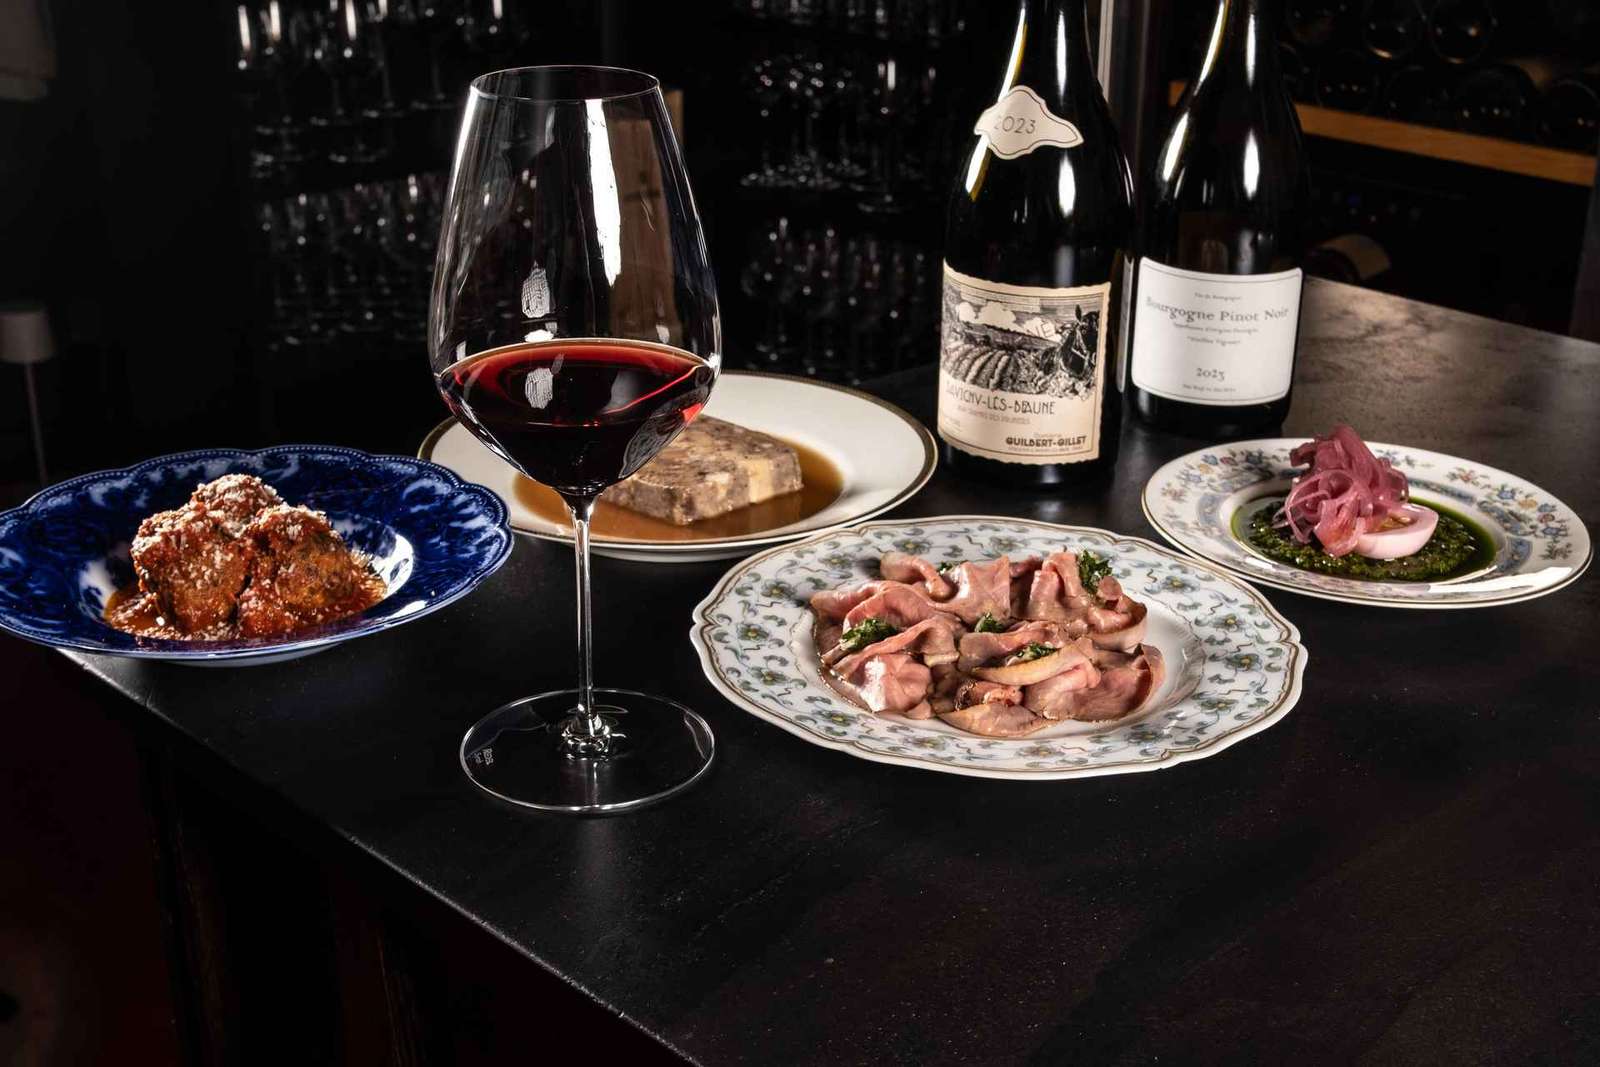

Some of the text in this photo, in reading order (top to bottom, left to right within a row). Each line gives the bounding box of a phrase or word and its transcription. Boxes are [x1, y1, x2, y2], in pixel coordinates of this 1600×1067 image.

[1220, 310, 1259, 322] Pinot
[1264, 308, 1289, 320] Noir
[1196, 367, 1225, 381] 2023
